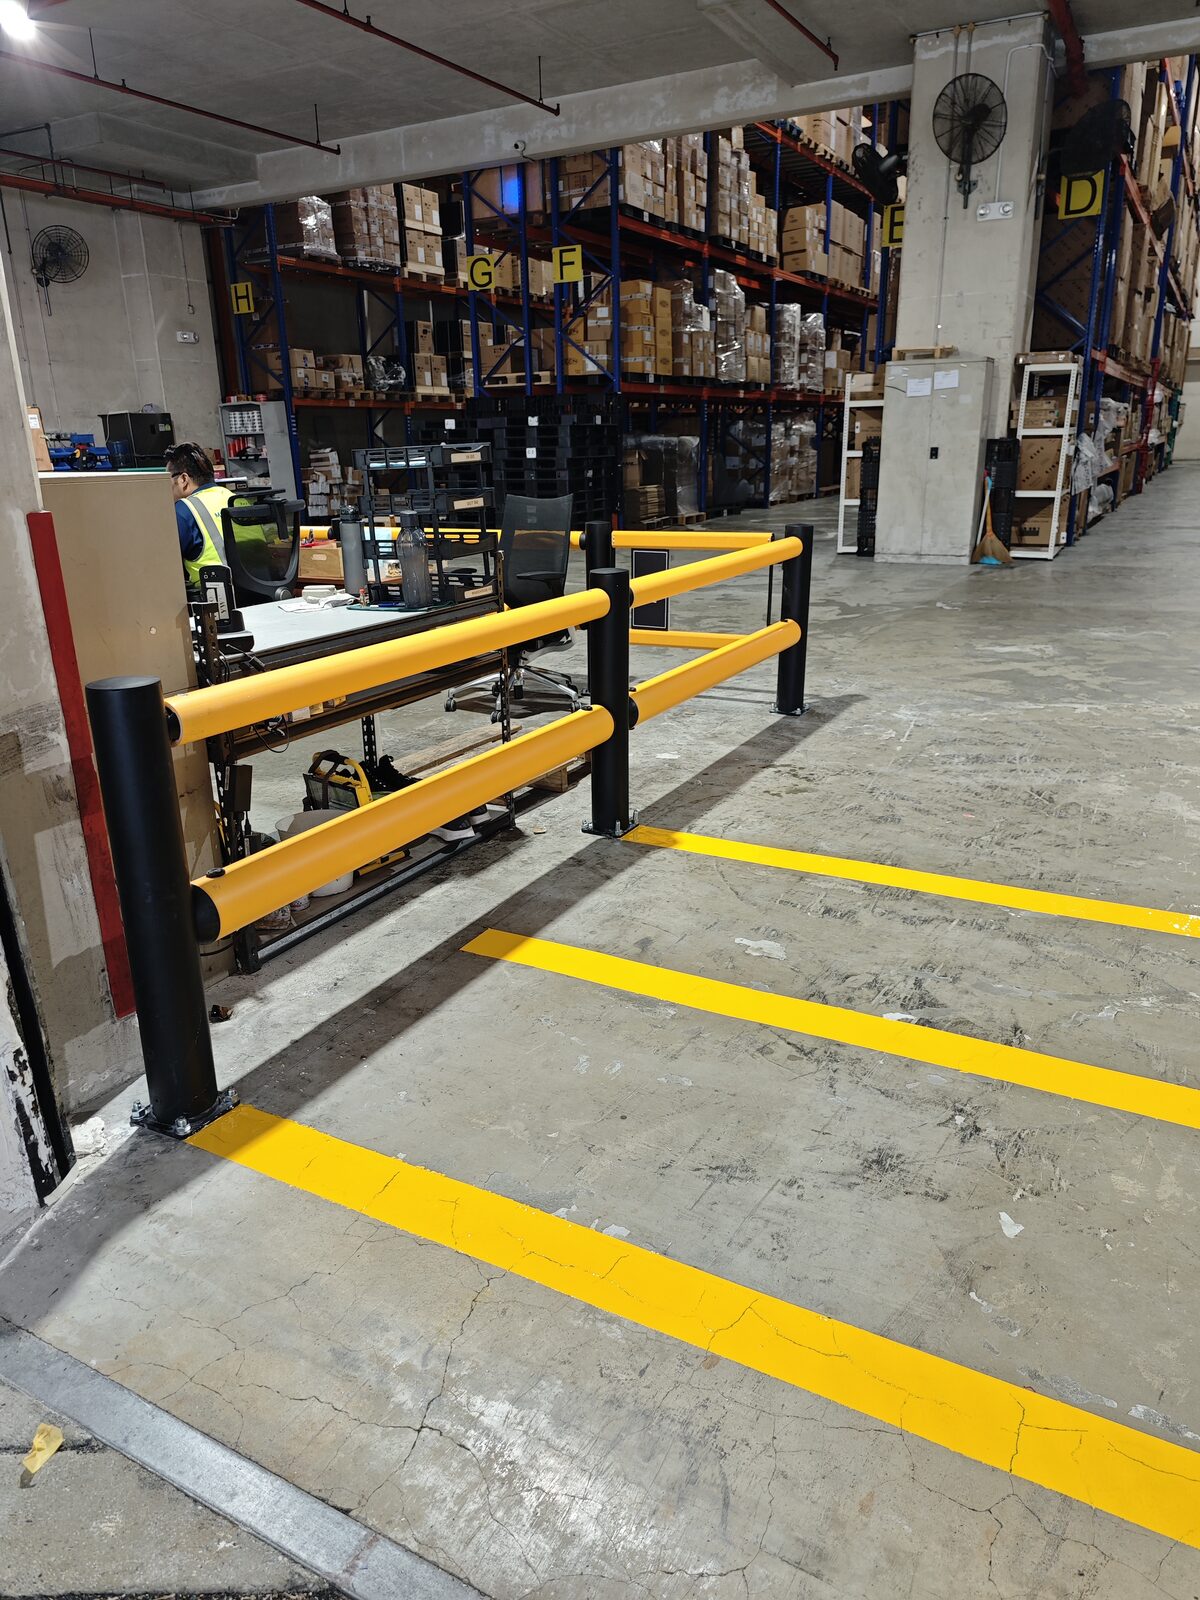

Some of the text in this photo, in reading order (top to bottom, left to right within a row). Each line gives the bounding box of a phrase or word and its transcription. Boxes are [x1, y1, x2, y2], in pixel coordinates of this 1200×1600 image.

[1065, 176, 1097, 215] D
[889, 206, 905, 243] E
[470, 257, 492, 288] G
[559, 247, 576, 280] F
[234, 284, 251, 312] H
